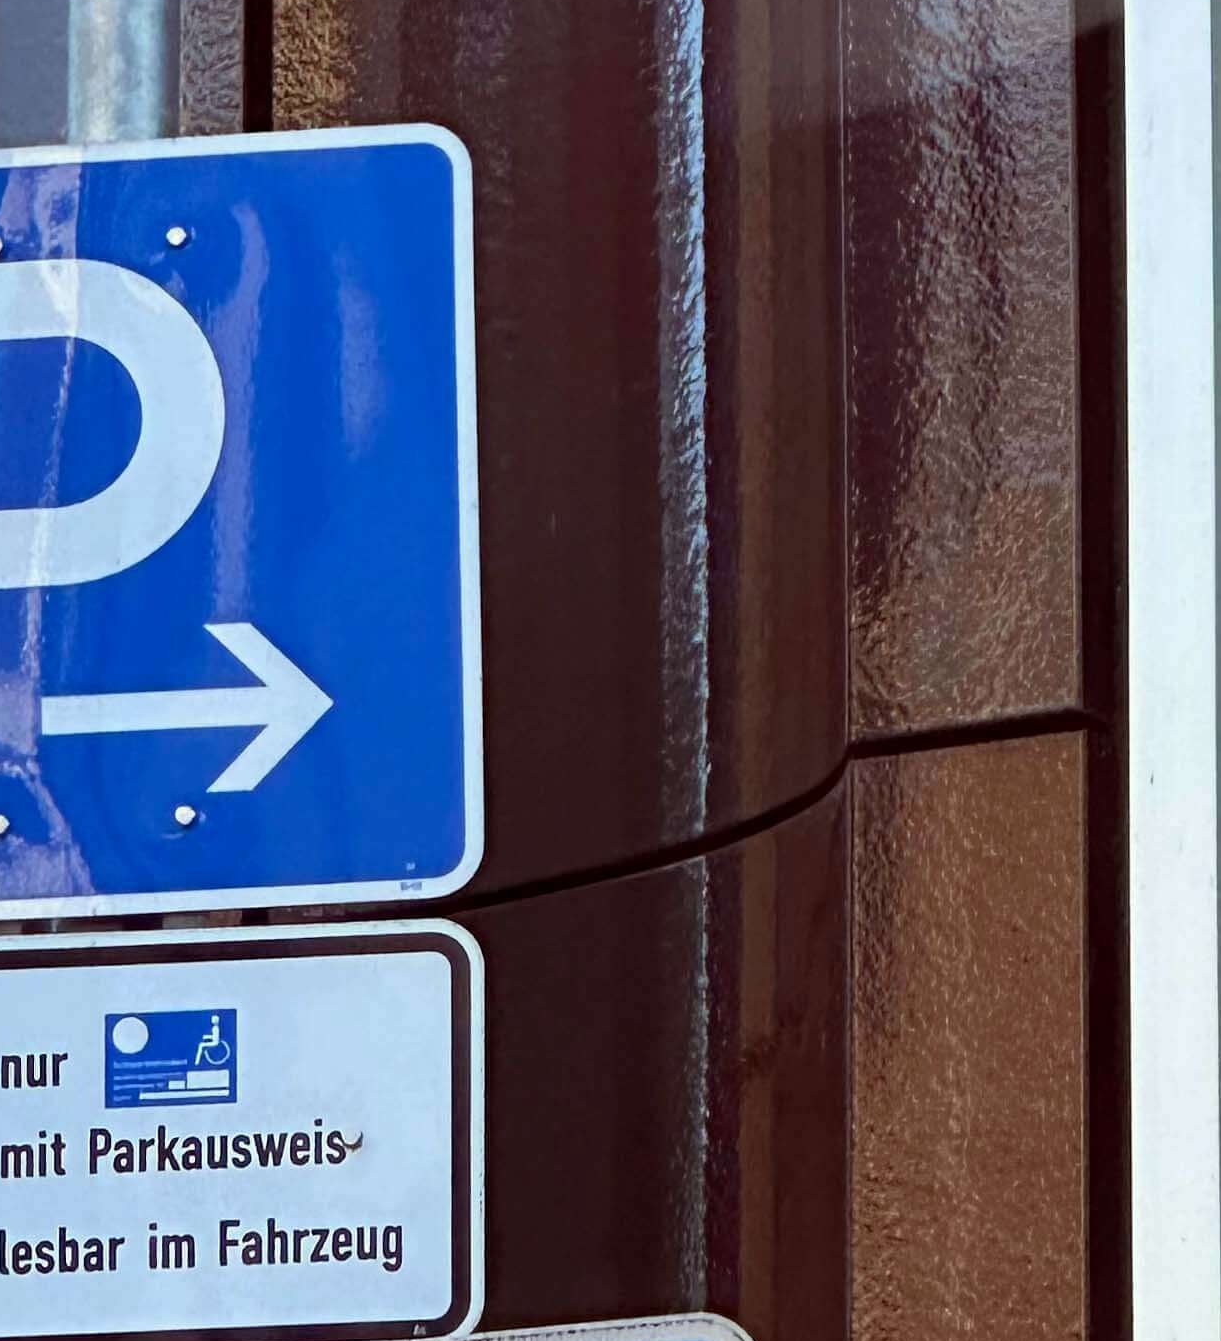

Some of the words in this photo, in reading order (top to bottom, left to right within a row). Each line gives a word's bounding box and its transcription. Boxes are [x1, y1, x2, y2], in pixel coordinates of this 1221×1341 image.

[0, 1052, 69, 1090] nur
[0, 1130, 67, 1179] mit
[89, 1118, 348, 1175] Parkausweis
[148, 1222, 196, 1270] im
[219, 1217, 404, 1272] Fahrzeug
